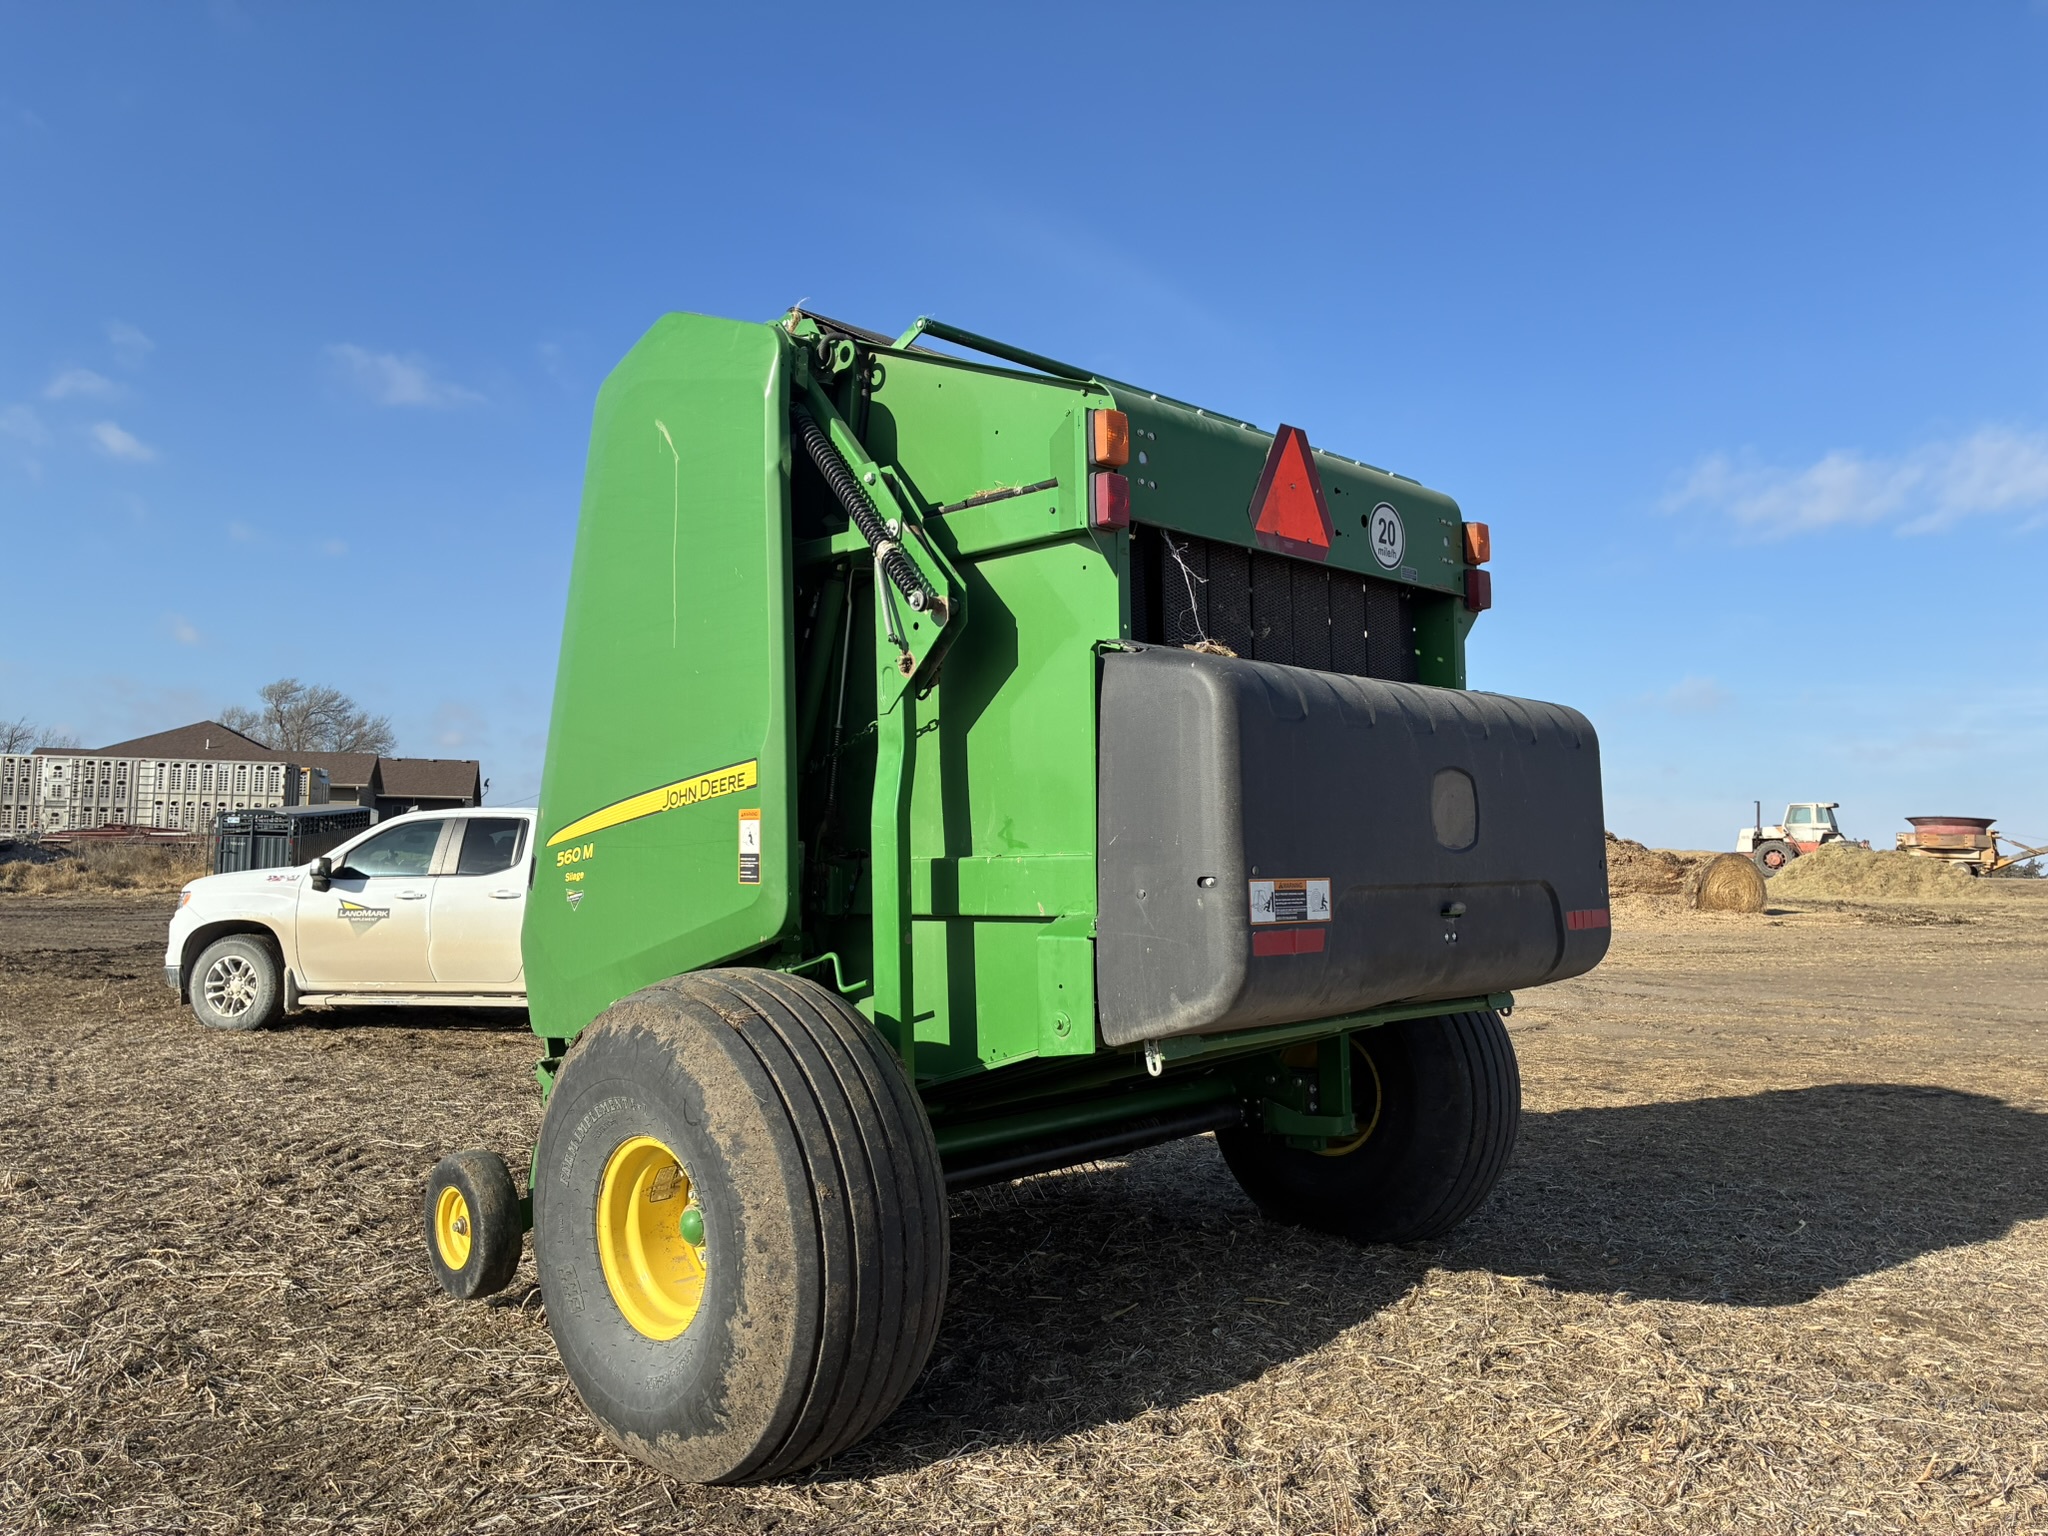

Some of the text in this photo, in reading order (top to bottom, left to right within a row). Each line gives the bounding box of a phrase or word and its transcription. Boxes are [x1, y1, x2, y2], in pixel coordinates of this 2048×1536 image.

[1378, 517, 1396, 547] 20
[1377, 547, 1397, 559] mile/h
[662, 772, 746, 809] JOHN DEERE
[556, 842, 594, 868] 560 M
[565, 871, 585, 883] Silage
[560, 1140, 580, 1187] FARM
[574, 1096, 628, 1143] IMPLEMENT
